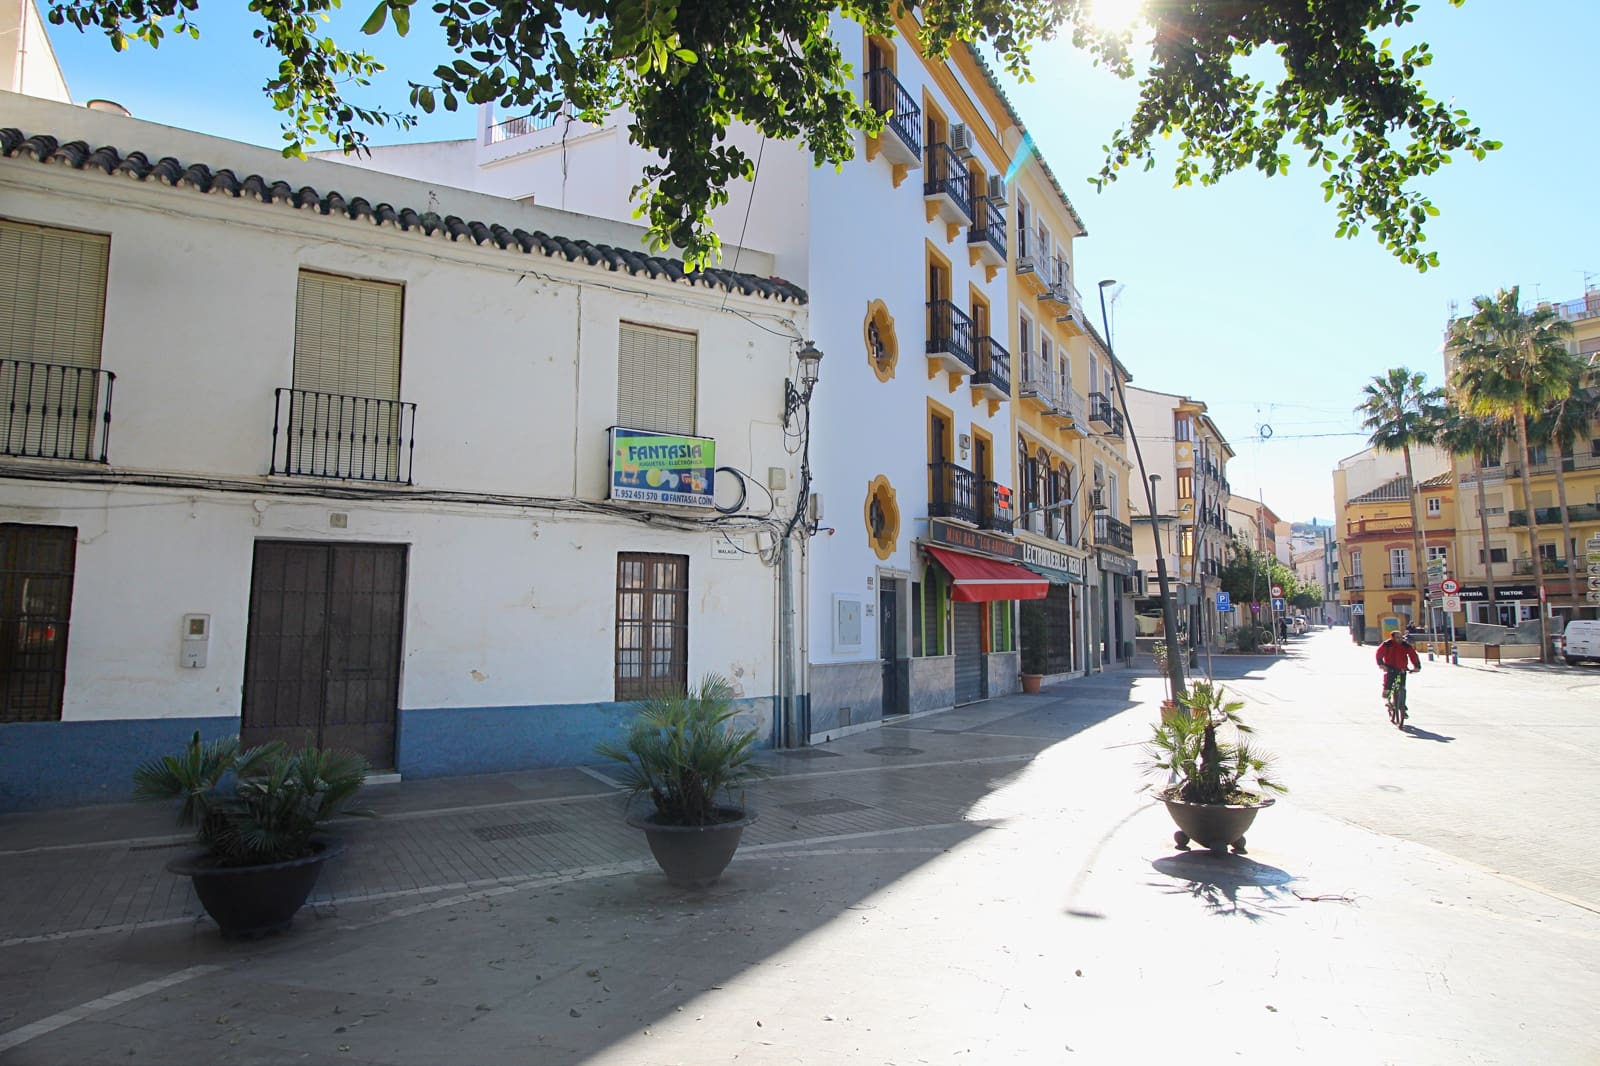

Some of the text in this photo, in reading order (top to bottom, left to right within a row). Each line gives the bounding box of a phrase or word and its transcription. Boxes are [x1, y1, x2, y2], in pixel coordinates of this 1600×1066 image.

[628, 444, 702, 461] FANTASIA
[621, 489, 632, 498] 952
[634, 490, 645, 499] 451
[647, 492, 658, 501] 570
[669, 494, 697, 504] FANTASIA
[1023, 543, 1068, 571] LECTROMUEBLES
